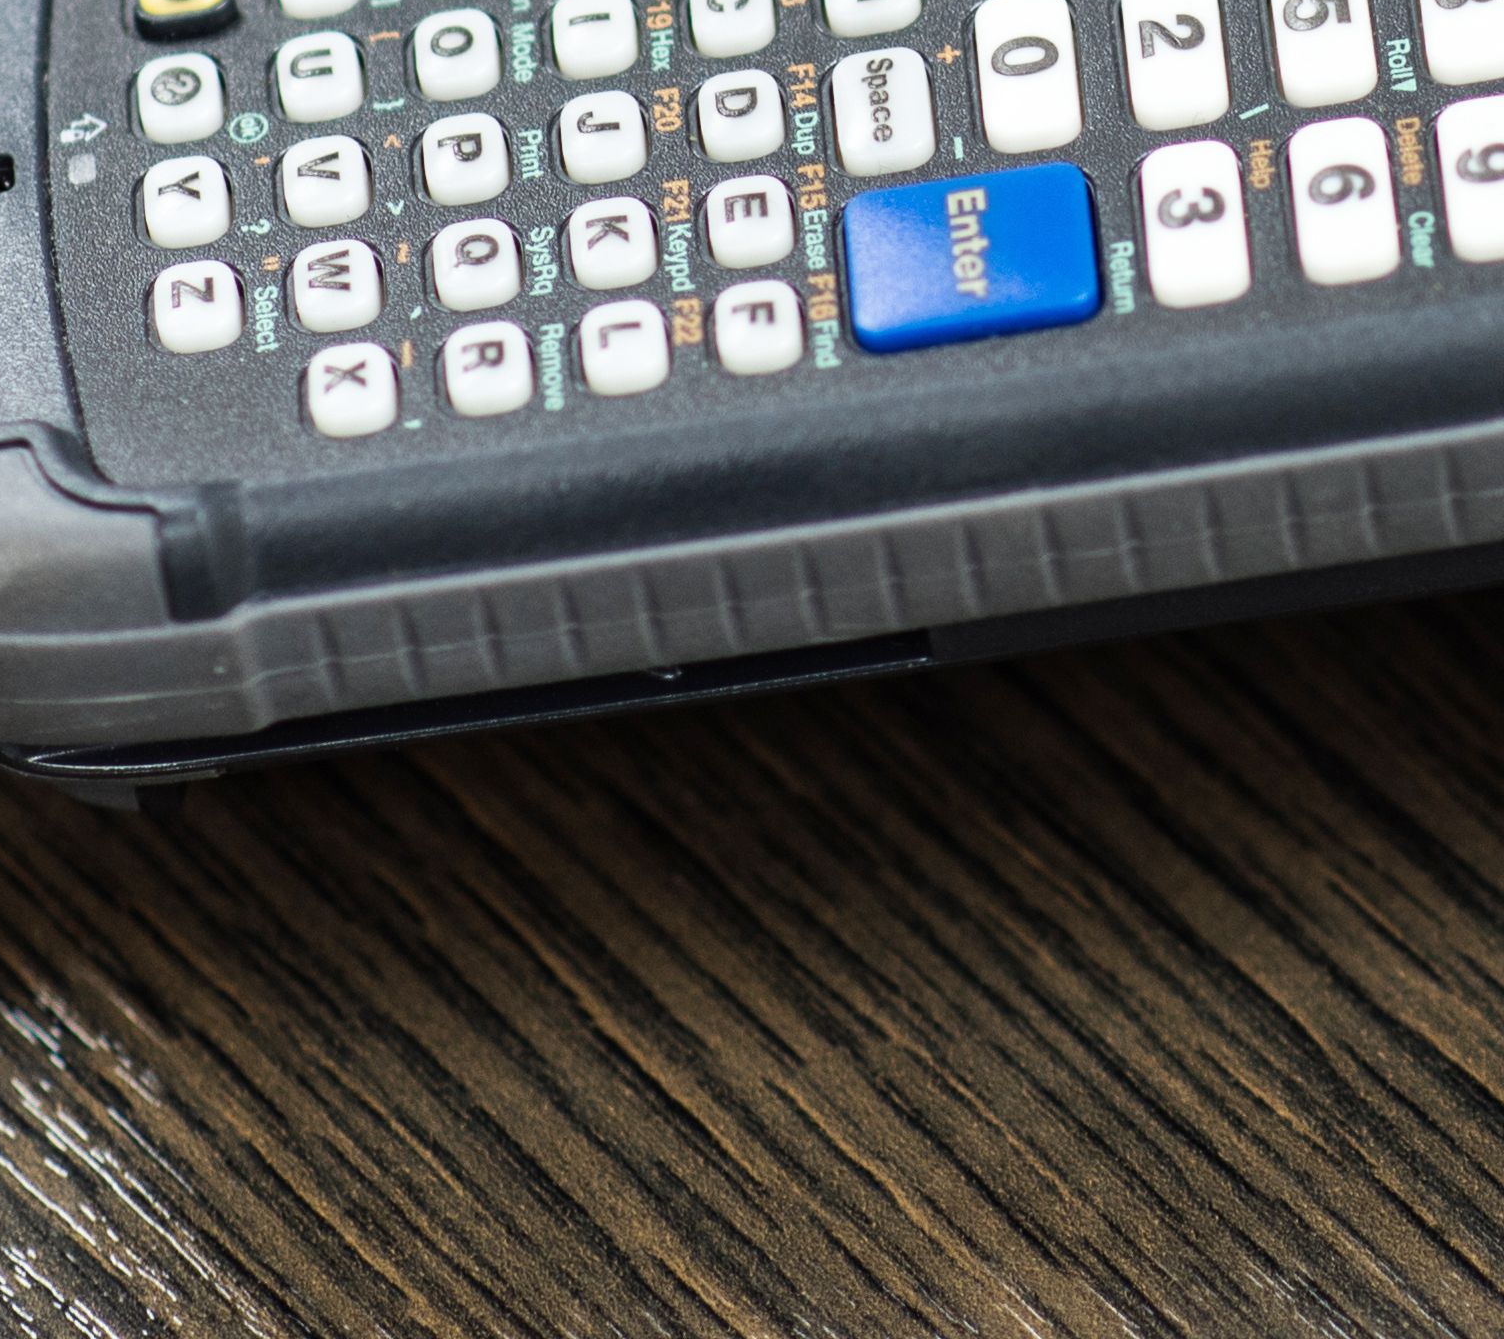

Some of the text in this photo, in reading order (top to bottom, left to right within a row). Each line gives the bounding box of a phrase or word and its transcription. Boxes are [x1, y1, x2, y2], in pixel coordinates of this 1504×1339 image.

[568, 12, 611, 27] I
[1139, 13, 1206, 59] 2
[430, 25, 474, 58] O
[512, 22, 537, 83] Mode
[649, 29, 674, 72] Hex
[935, 44, 962, 65] +
[990, 35, 1060, 76] 0
[290, 48, 333, 80] U
[653, 86, 682, 133] F20
[715, 86, 758, 118] D
[787, 62, 819, 155] F14 Dup
[861, 57, 894, 143] Space
[576, 111, 621, 134] J
[297, 151, 341, 181] V
[437, 131, 483, 163] P
[517, 129, 544, 180] Print
[1247, 139, 1274, 190] Help
[158, 171, 201, 200] Y
[1308, 164, 1376, 206] 6
[1395, 117, 1436, 268] Delete Clear
[240, 218, 271, 235] ?
[724, 191, 768, 224] E
[796, 163, 829, 270] F15 Erase
[1157, 187, 1226, 230] 3
[454, 233, 500, 268] Q
[585, 214, 630, 250] K
[662, 178, 696, 292] F21 Keypd
[944, 187, 990, 299] Enter
[307, 249, 351, 292] W
[526, 225, 557, 297] SysRq
[1108, 240, 1135, 315] Return
[171, 276, 215, 309] Z
[731, 300, 776, 324] F
[253, 285, 281, 353] Select
[598, 320, 642, 350] L
[673, 297, 703, 346] F22
[807, 273, 843, 369] F16 Find
[324, 360, 367, 394] X
[461, 339, 505, 374] R
[539, 323, 565, 412] Remove
